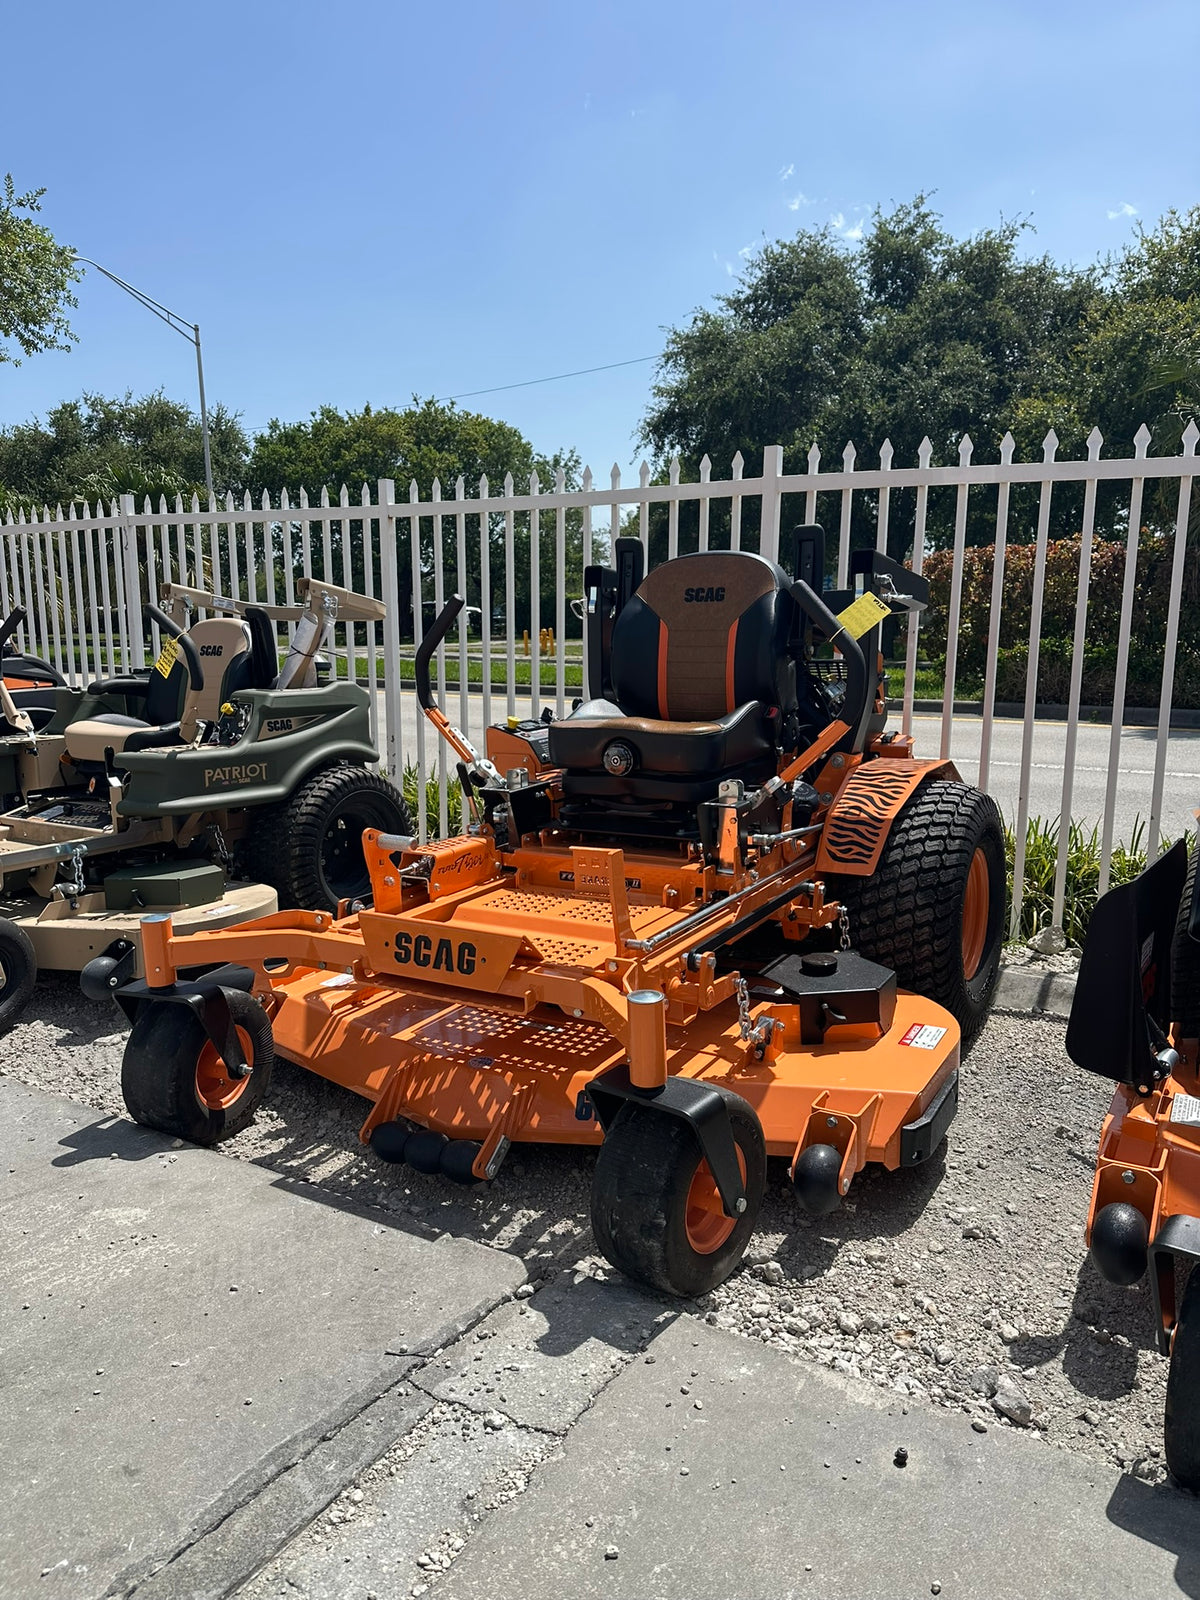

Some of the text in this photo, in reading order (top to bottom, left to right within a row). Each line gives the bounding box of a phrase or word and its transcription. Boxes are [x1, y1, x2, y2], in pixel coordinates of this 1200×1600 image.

[684, 587, 726, 602] SCAG
[200, 645, 223, 657] SCAG
[267, 719, 293, 732] SCAG
[204, 763, 268, 788] PATRIOT
[394, 932, 477, 976] SCAG
